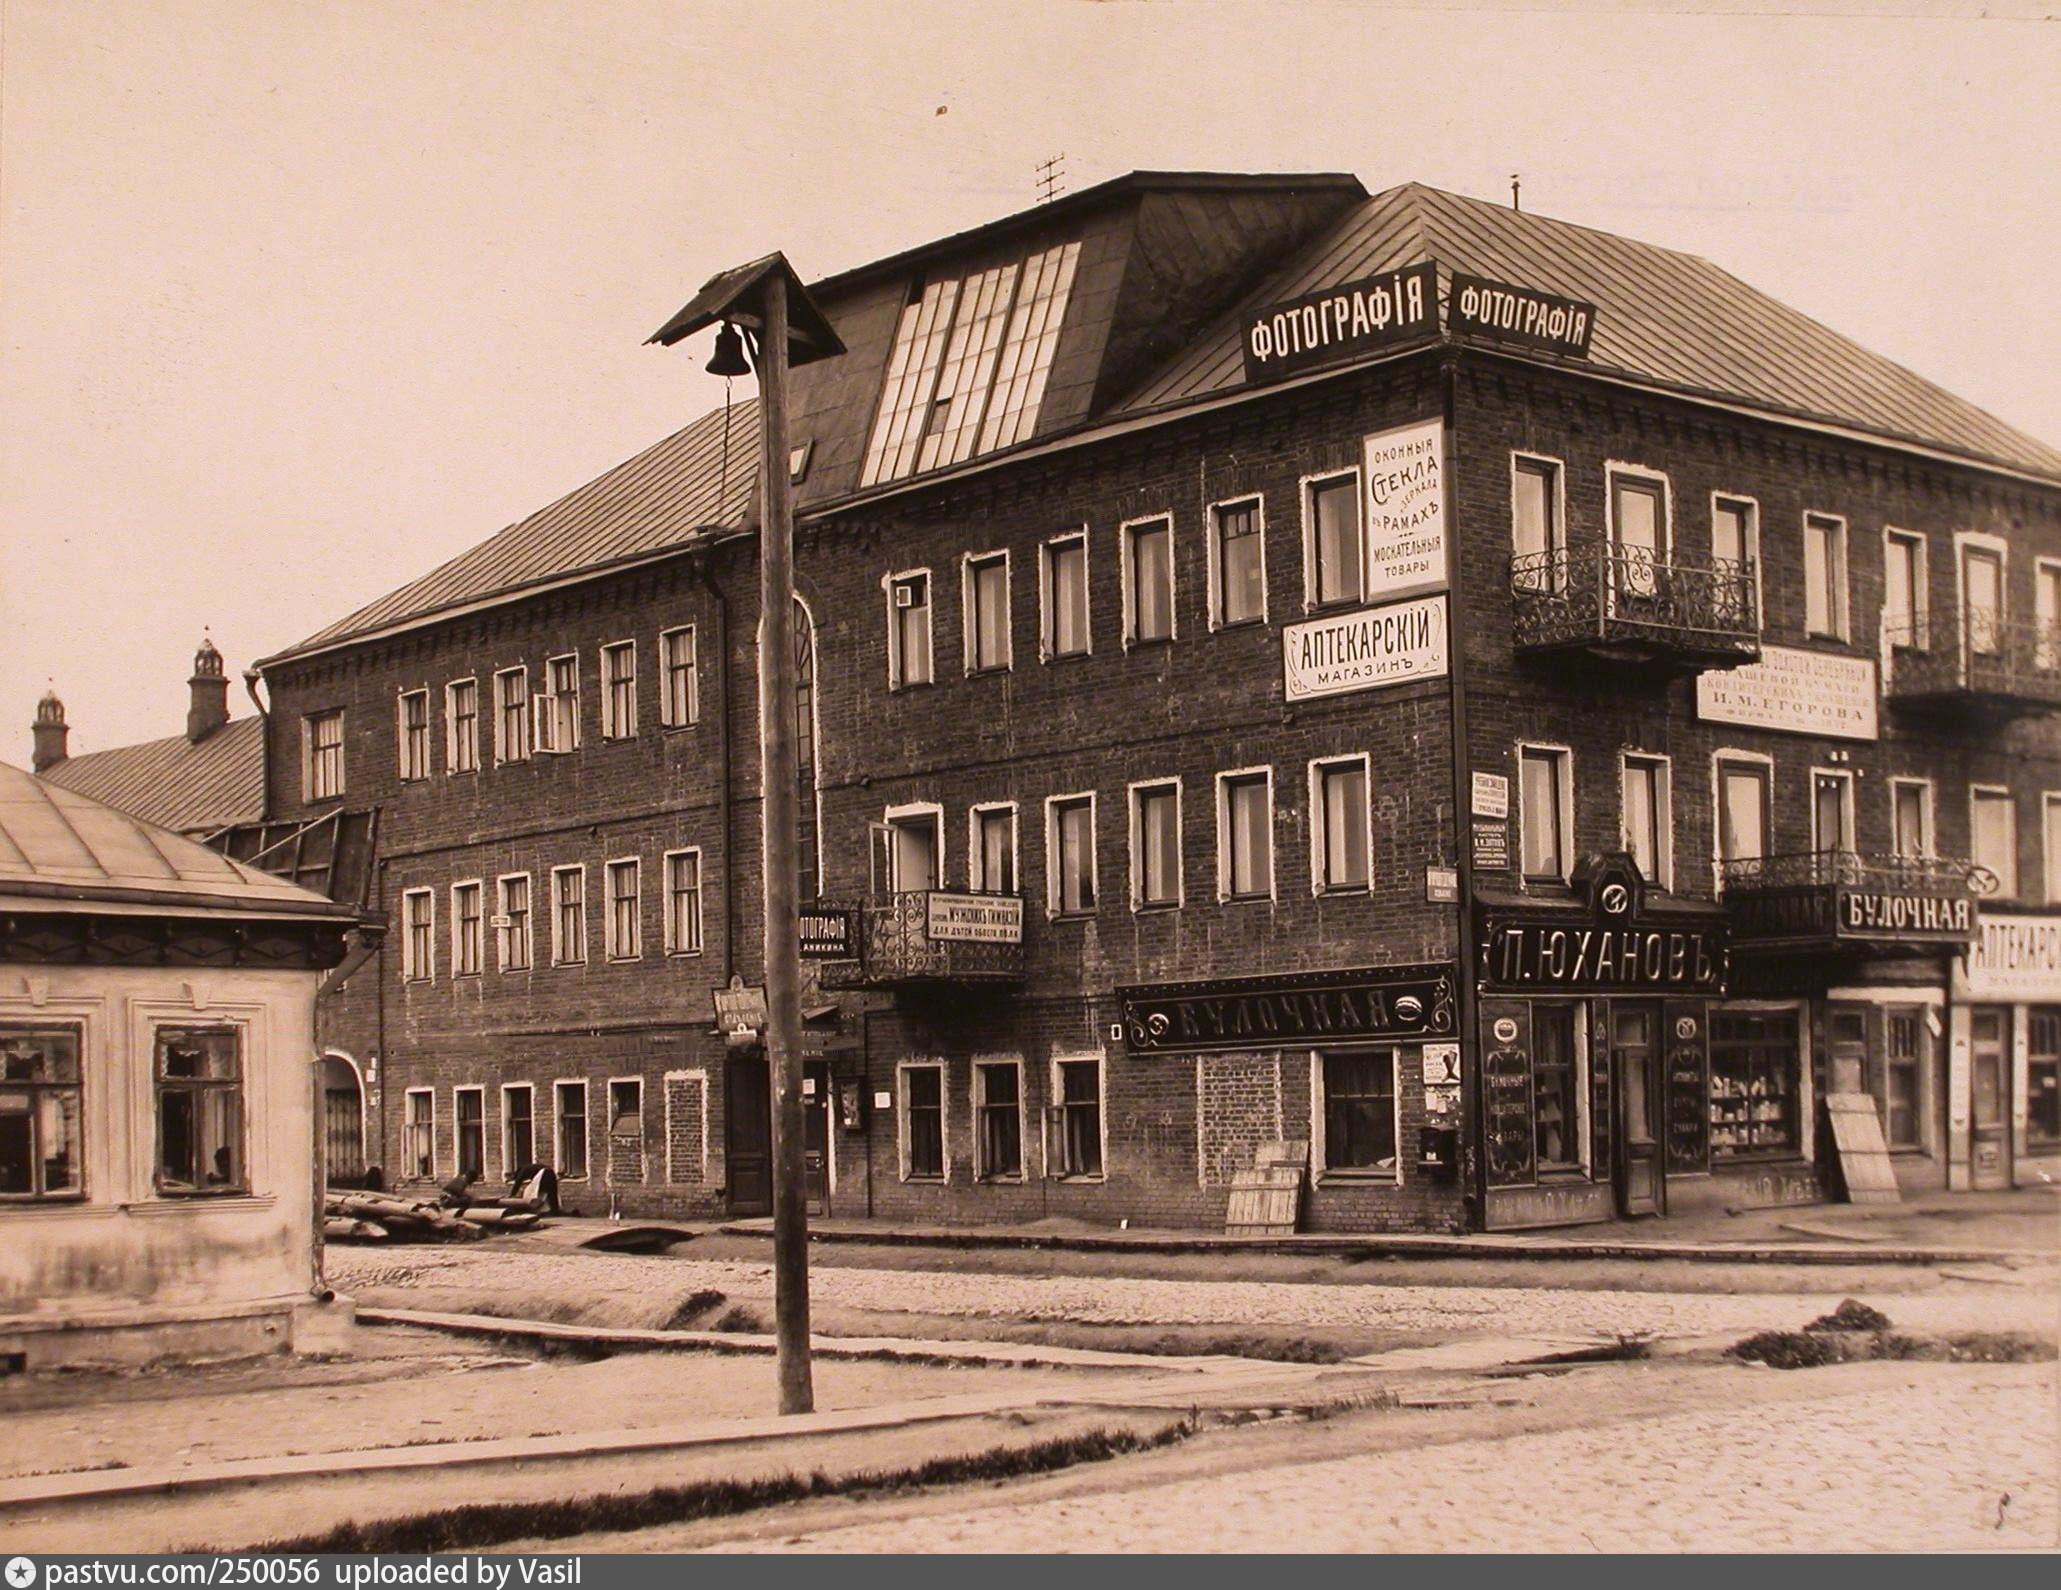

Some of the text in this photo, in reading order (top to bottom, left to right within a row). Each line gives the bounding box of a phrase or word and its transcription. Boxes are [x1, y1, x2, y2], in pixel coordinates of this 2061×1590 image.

[1251, 274, 1423, 363] ФОТОГРАФІЯ
[1460, 285, 1587, 346] ФОТОГРАФІЯ
[1374, 438, 1433, 464] ОКОННЫЯ
[1371, 455, 1439, 506] СТЕКЛА
[1382, 501, 1439, 531] РАМАХЪ
[1374, 535, 1441, 563] МОСКАТЕЛЬНЫЯ
[1384, 560, 1430, 578] ТОВАРЫ
[1301, 607, 1430, 671] АПТЕКАРСКІЙ
[1317, 658, 1414, 685] МАГАЗИНЪ
[1738, 695, 1757, 707] М.
[1763, 698, 1863, 721] ЕГОРОВА
[799, 914, 846, 940] ОТОГРАФІЯ
[1849, 894, 1971, 931] БУЛОЧНАЯ
[1502, 929, 1712, 982] П. ЮХАНОВЪ
[1976, 923, 2061, 970] АПТЕКАРС
[1178, 990, 1390, 1036] БУЛОЧНАЯ
